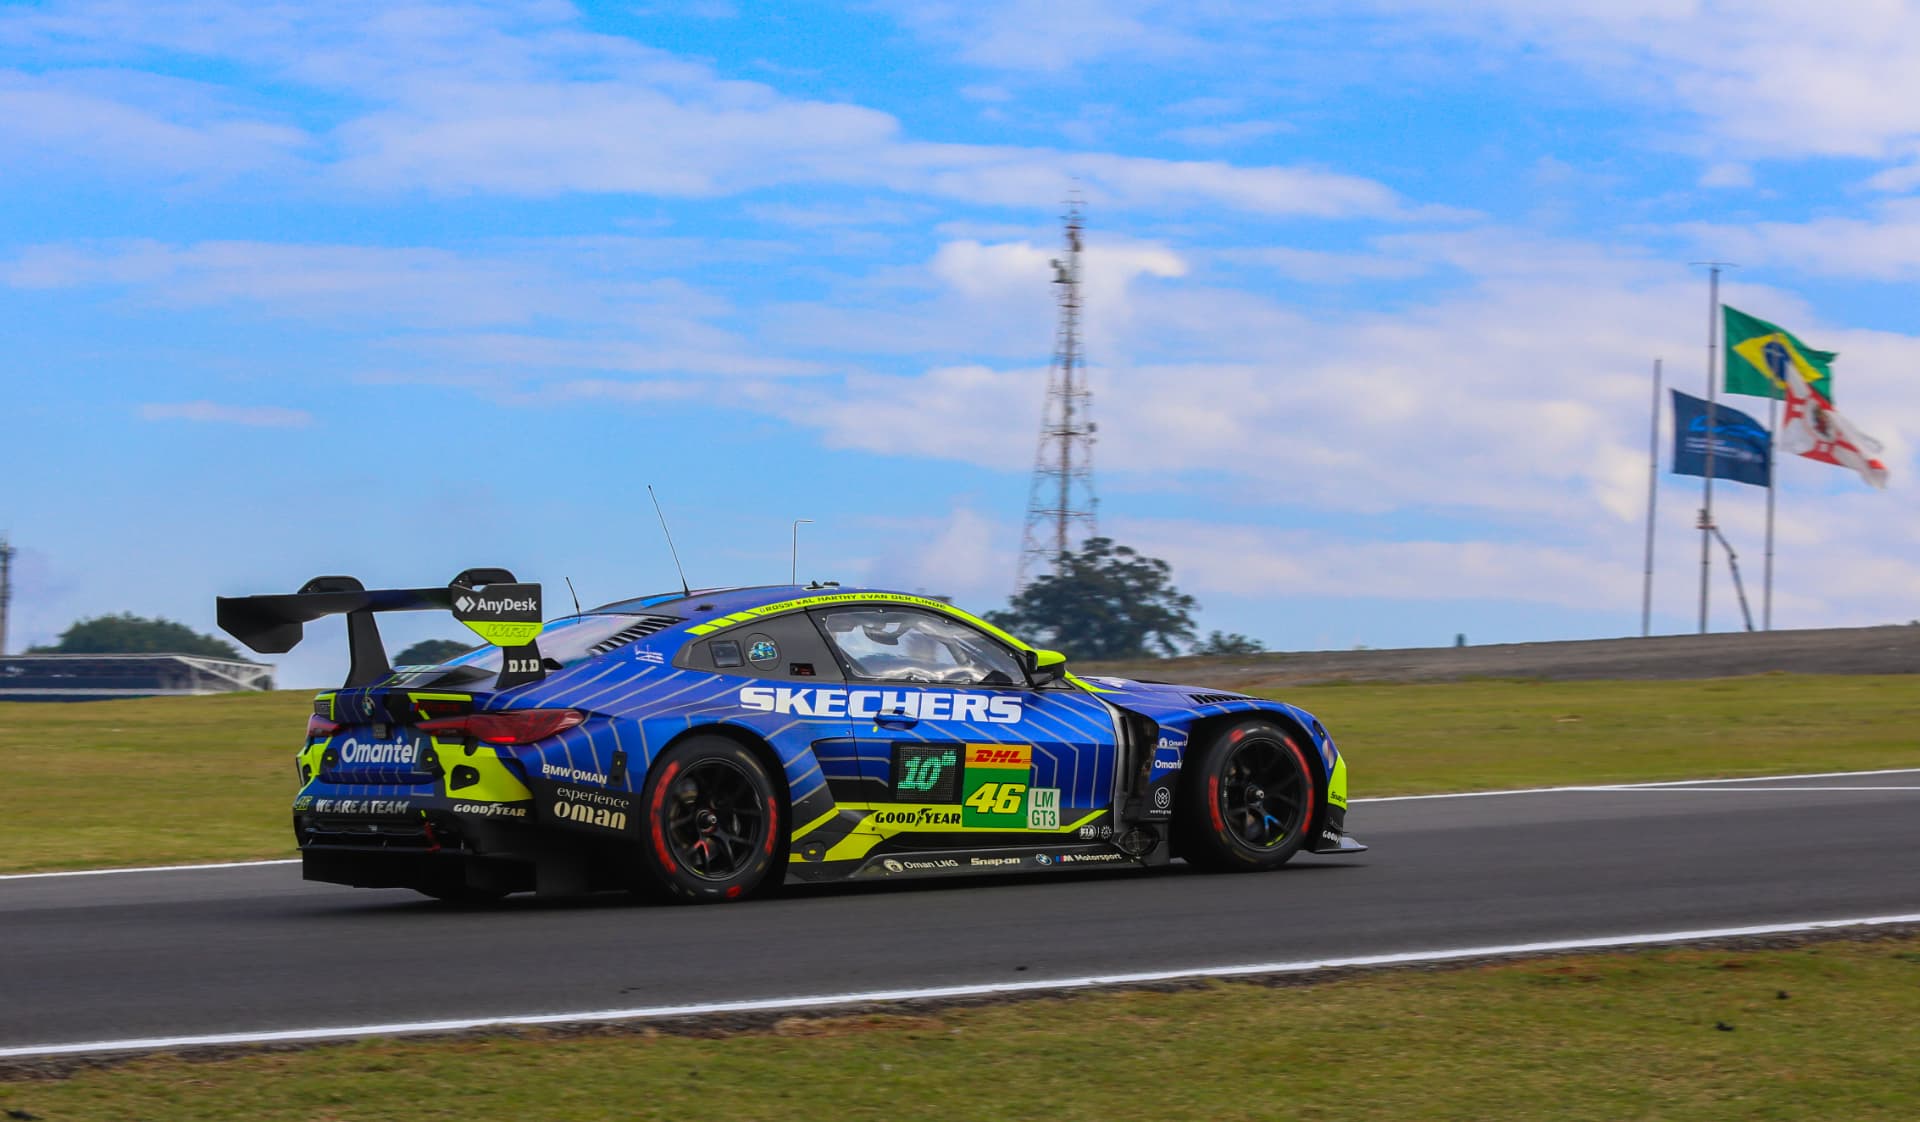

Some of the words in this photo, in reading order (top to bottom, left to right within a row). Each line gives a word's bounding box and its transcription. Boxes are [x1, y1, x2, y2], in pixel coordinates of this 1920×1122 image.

[477, 598, 537, 614] AnyDesk
[765, 602, 793, 612] ROSSI
[486, 624, 536, 638] WRT
[508, 659, 540, 673] D.I.D
[740, 687, 1022, 724] SKECHERS
[341, 736, 421, 764] Omantel
[975, 750, 1023, 763] DHL
[542, 763, 572, 778] BMW
[572, 769, 608, 785] OMAN
[557, 786, 630, 809] experience
[965, 782, 1026, 814] 46
[1034, 791, 1054, 807] LM
[370, 800, 410, 813] TEAM
[553, 801, 627, 830] oman
[1031, 810, 1057, 827] GT3
[903, 860, 935, 870] Oman
[937, 859, 959, 868] LNG
[970, 857, 1021, 866] Snap-on
[1074, 853, 1122, 863] Motorsport
